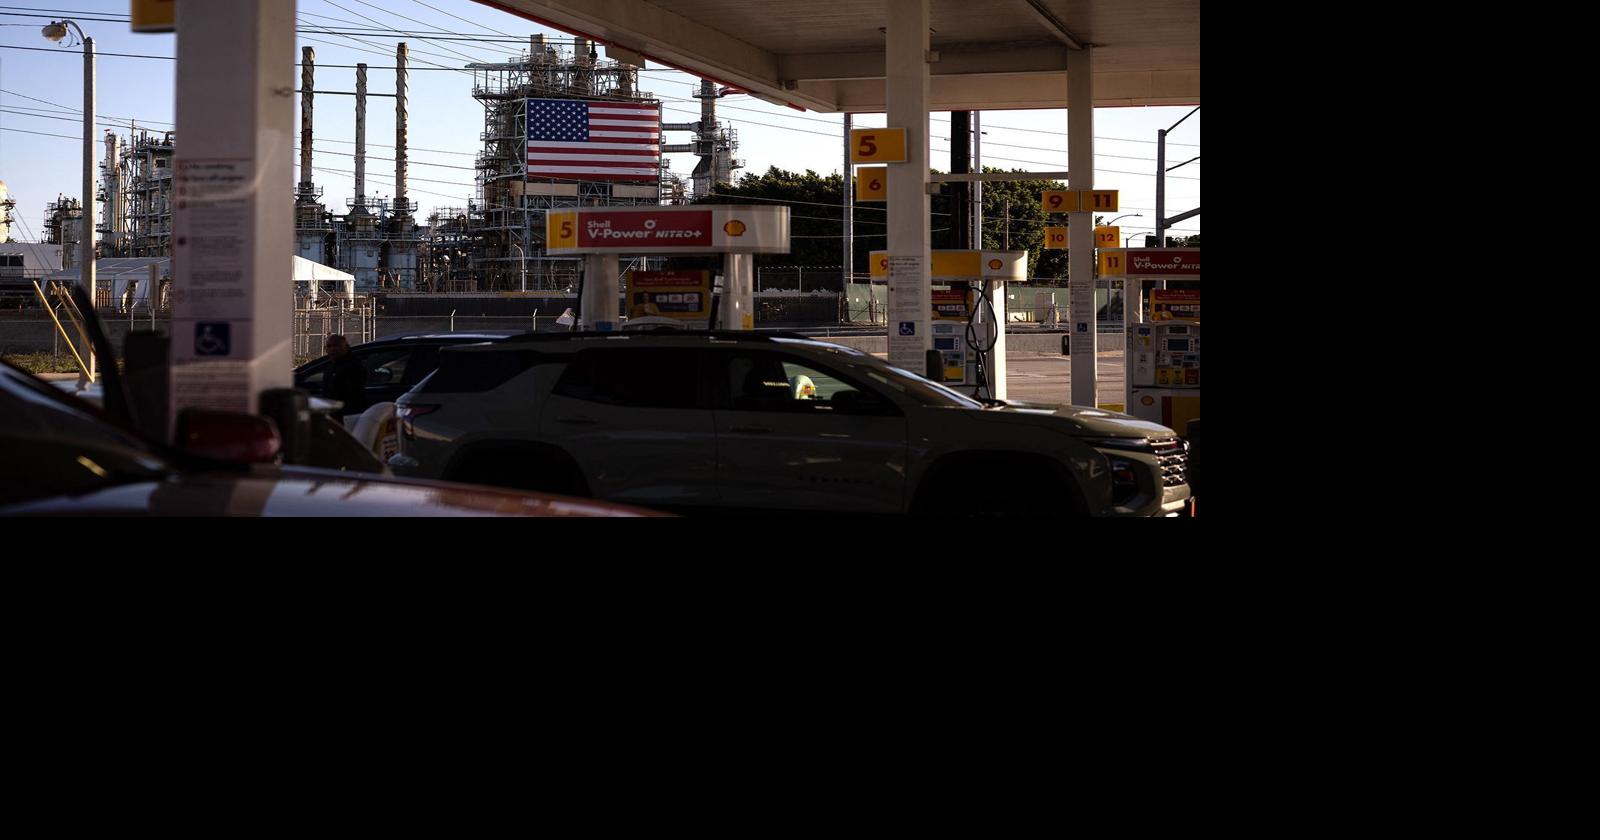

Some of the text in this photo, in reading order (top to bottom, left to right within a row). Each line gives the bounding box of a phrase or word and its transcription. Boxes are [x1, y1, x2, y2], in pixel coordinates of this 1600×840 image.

[858, 135, 878, 157] 5
[869, 179, 882, 191] 6
[1049, 195, 1064, 208] 9
[1092, 194, 1111, 208] 11
[560, 221, 573, 239] 5
[587, 220, 611, 229] Shell
[587, 229, 703, 239] V-Power NITRO+
[1051, 233, 1065, 242] 10
[1100, 233, 1114, 242] 12
[1106, 257, 1119, 268] 11
[1133, 262, 1177, 270] V-Power
